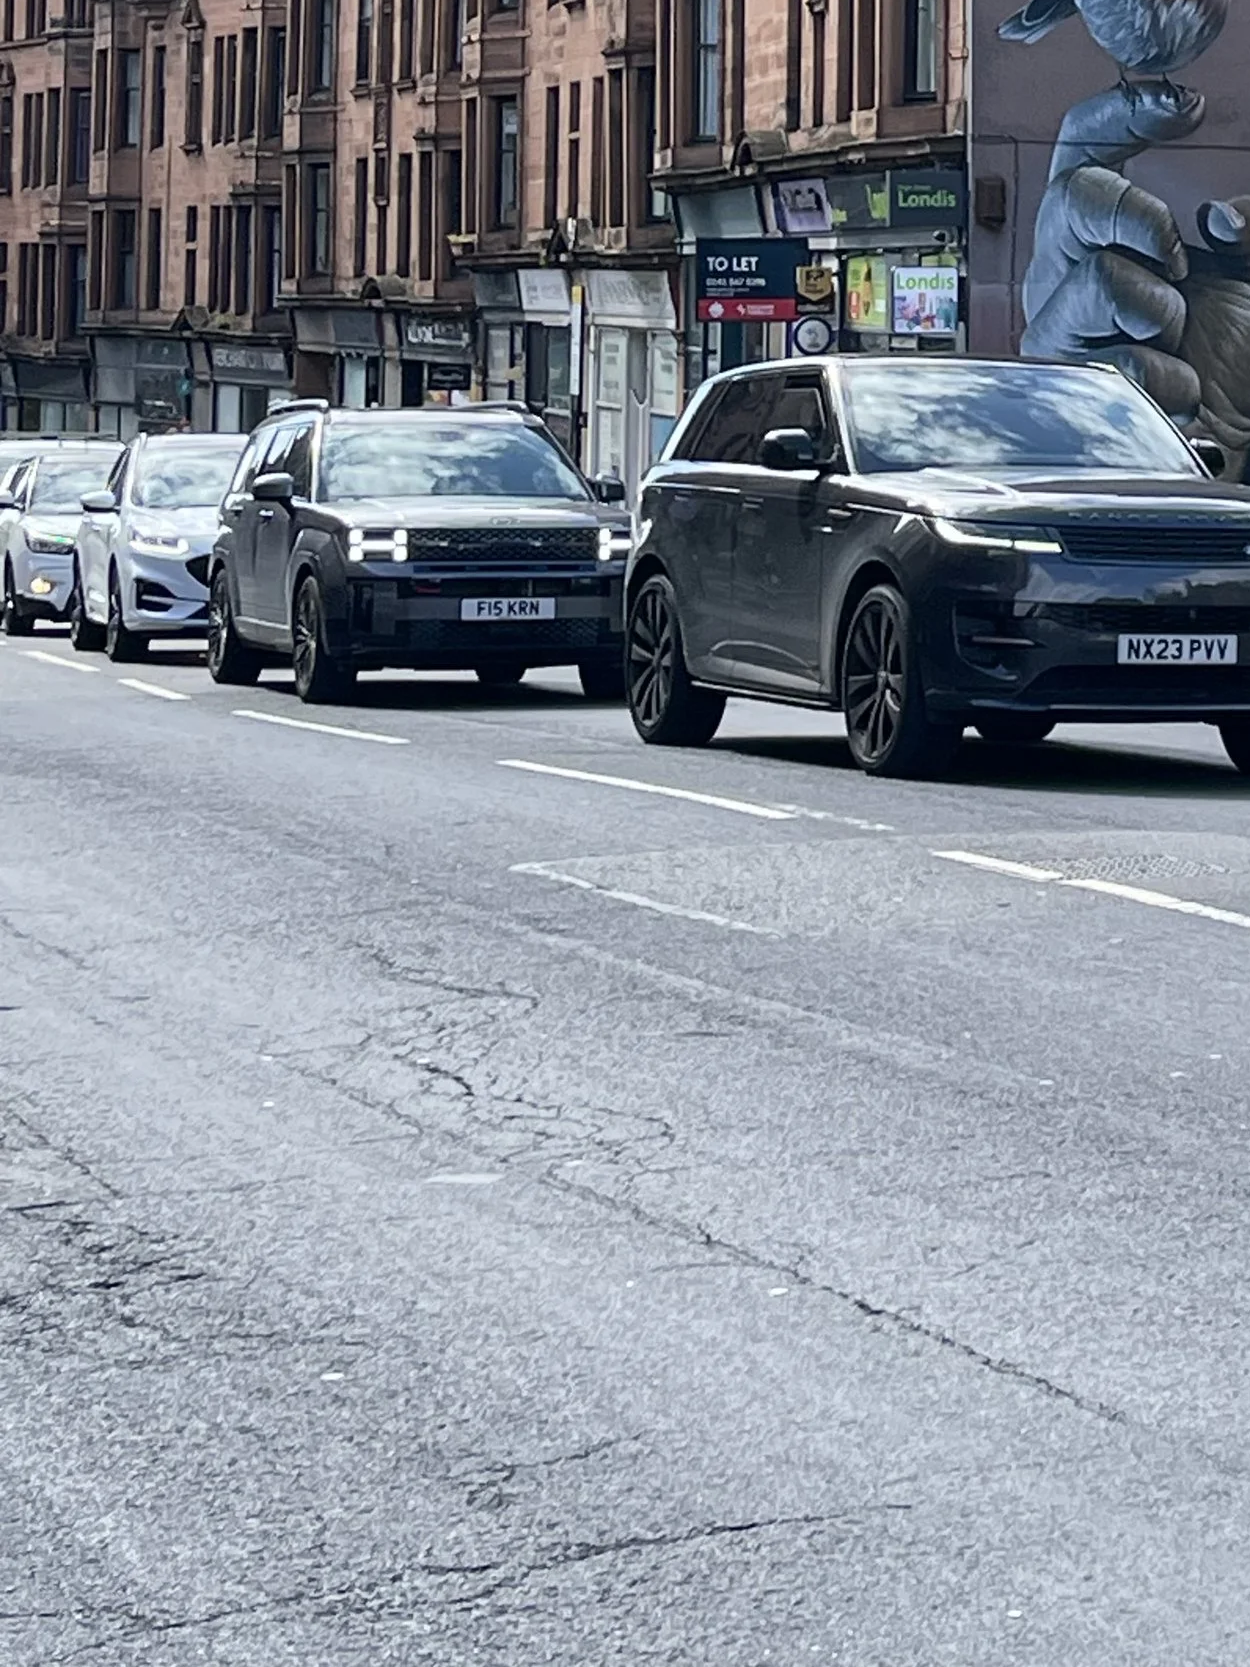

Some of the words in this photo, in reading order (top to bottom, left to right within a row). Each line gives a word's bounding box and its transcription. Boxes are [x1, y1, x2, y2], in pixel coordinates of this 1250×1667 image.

[898, 189, 956, 207] Londis
[706, 256, 729, 272] TO
[732, 256, 759, 272] LET
[896, 273, 956, 291] Londis
[476, 600, 503, 617] F15
[507, 600, 540, 616] KRN
[1127, 638, 1183, 661] NX23
[1188, 638, 1229, 661] PVV
